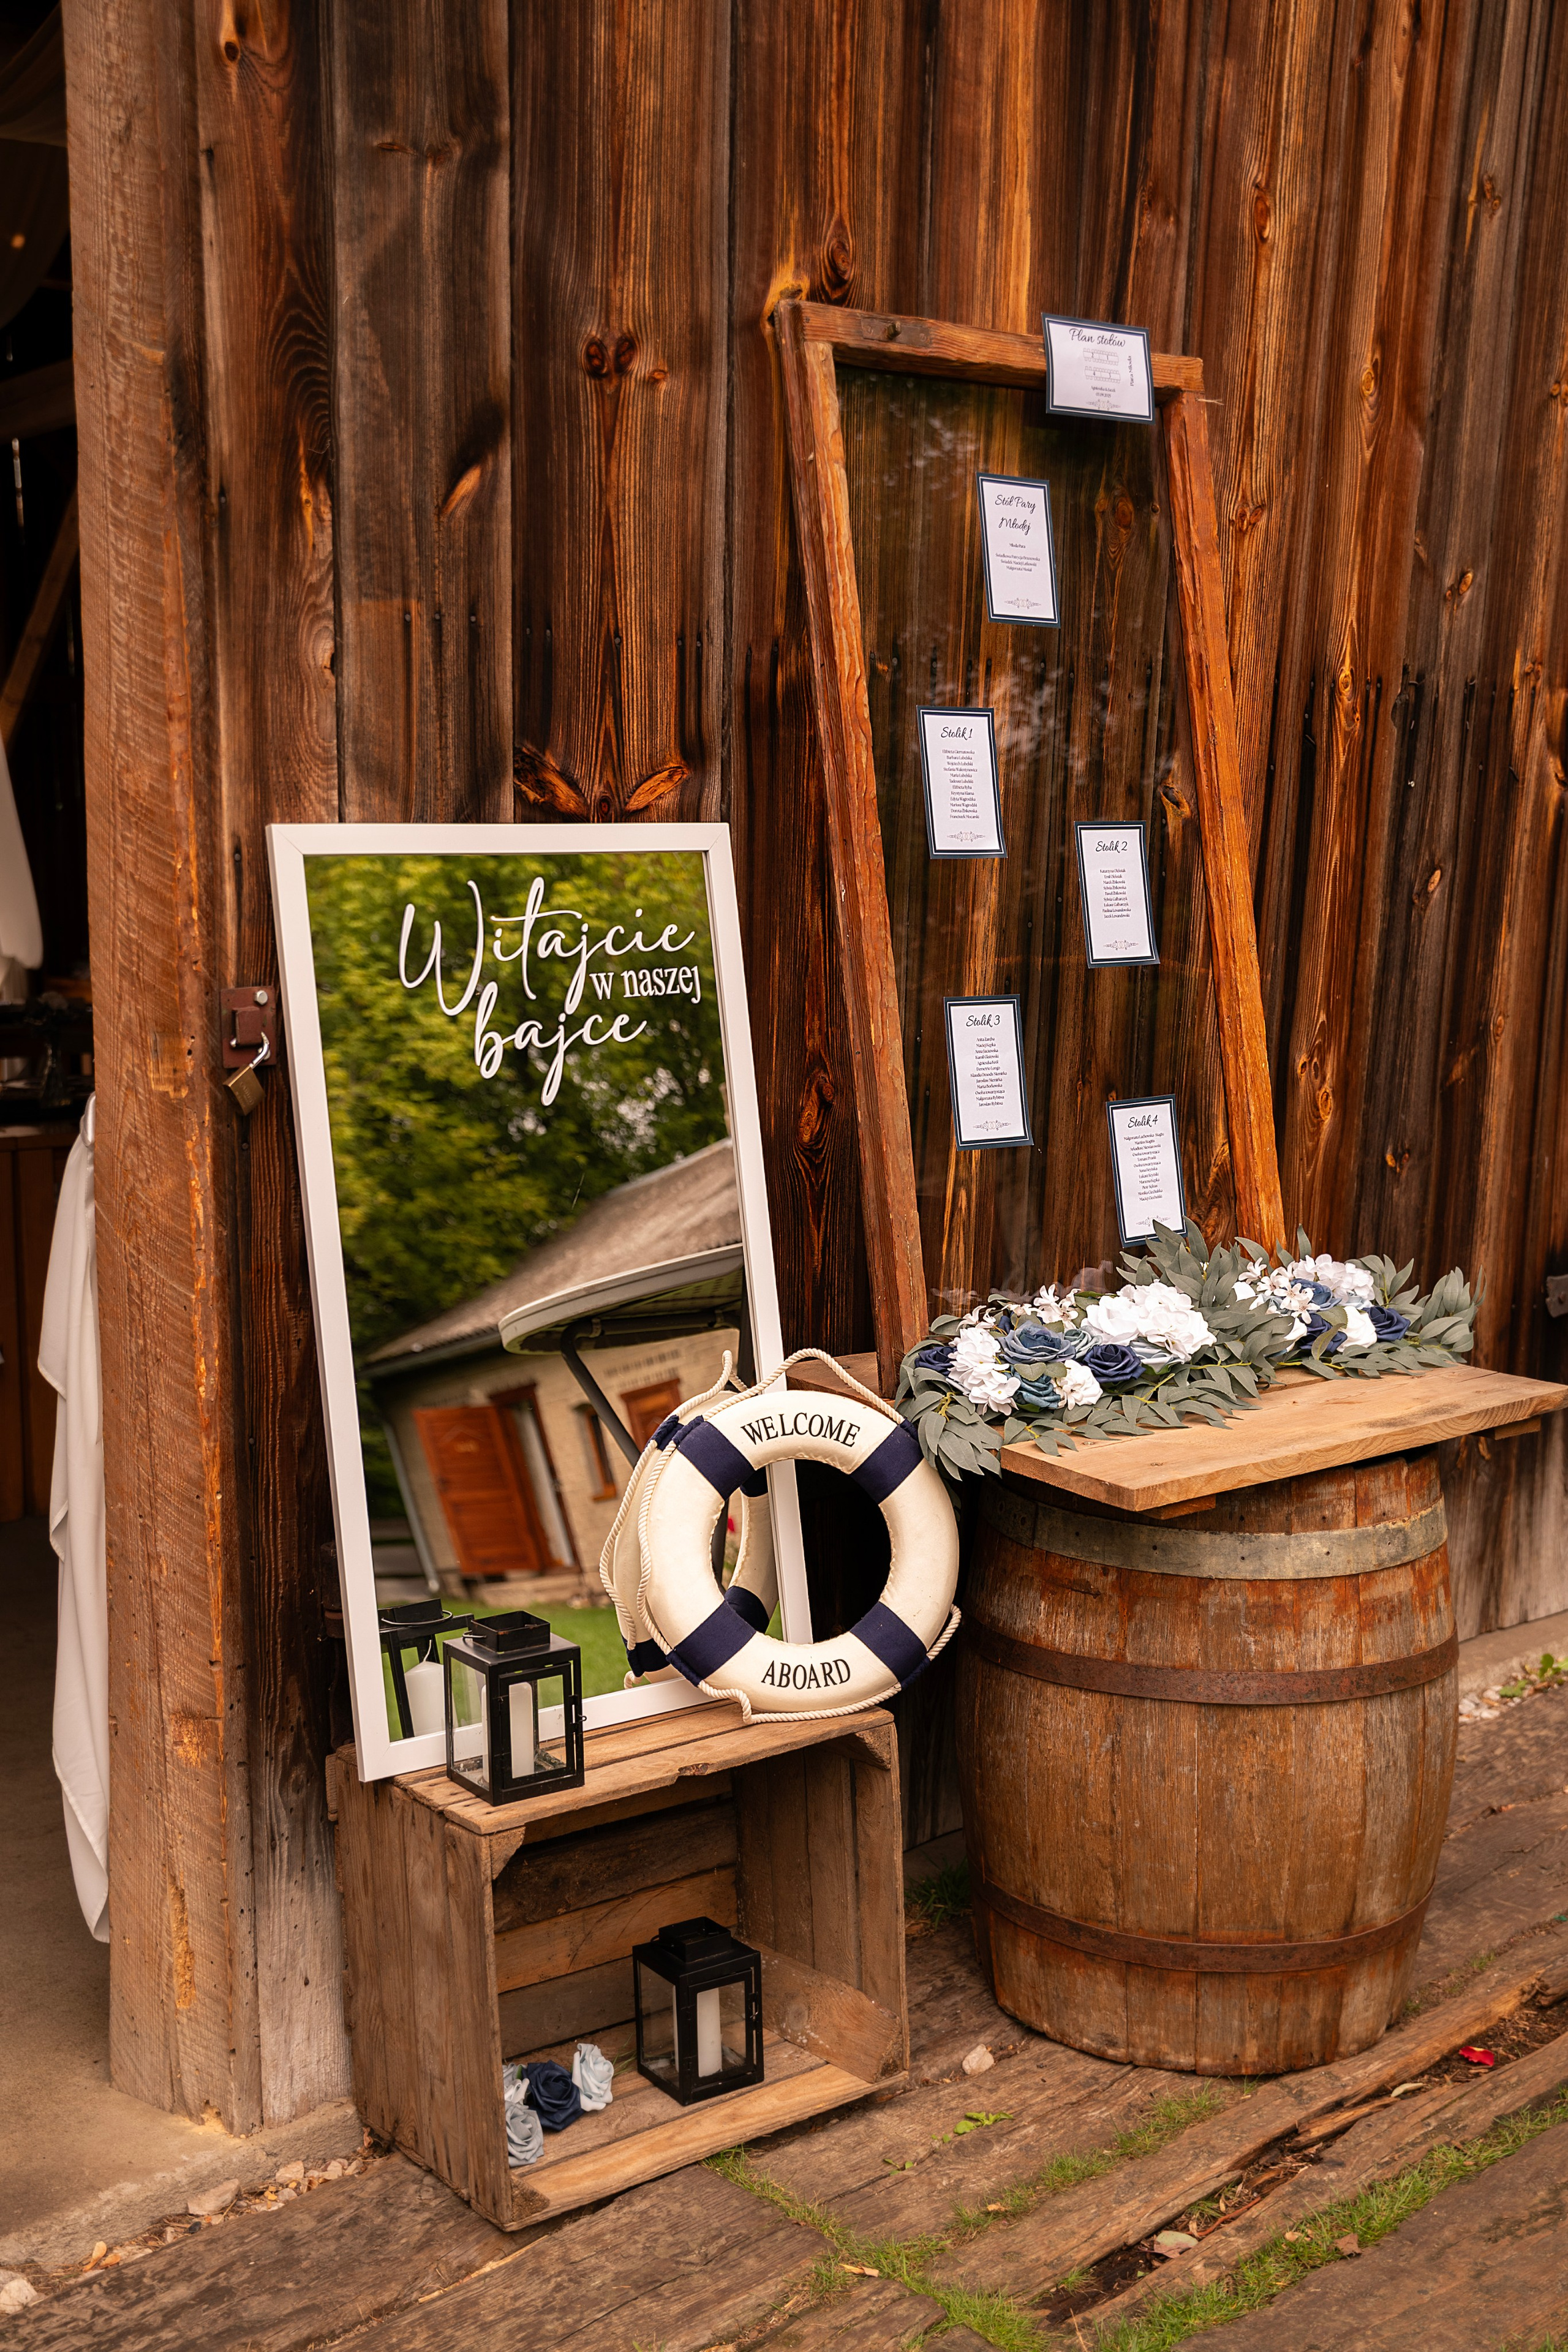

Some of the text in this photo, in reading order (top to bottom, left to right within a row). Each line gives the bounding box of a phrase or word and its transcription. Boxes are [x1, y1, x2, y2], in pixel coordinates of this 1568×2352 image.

[1069, 328, 1095, 342] Plan
[1014, 497, 1036, 514] Pary
[941, 726, 973, 741] Stolik 1
[1096, 840, 1128, 853] Stolik 2
[399, 876, 695, 1016] Witajcie
[589, 965, 700, 1004] w naszej
[966, 1014, 1000, 1027] Stolik 3
[475, 981, 647, 1106] bajce
[1128, 1115, 1158, 1128] Stolik 4
[741, 1412, 861, 1449] WELCOME
[761, 1658, 851, 1690] ABOARD
